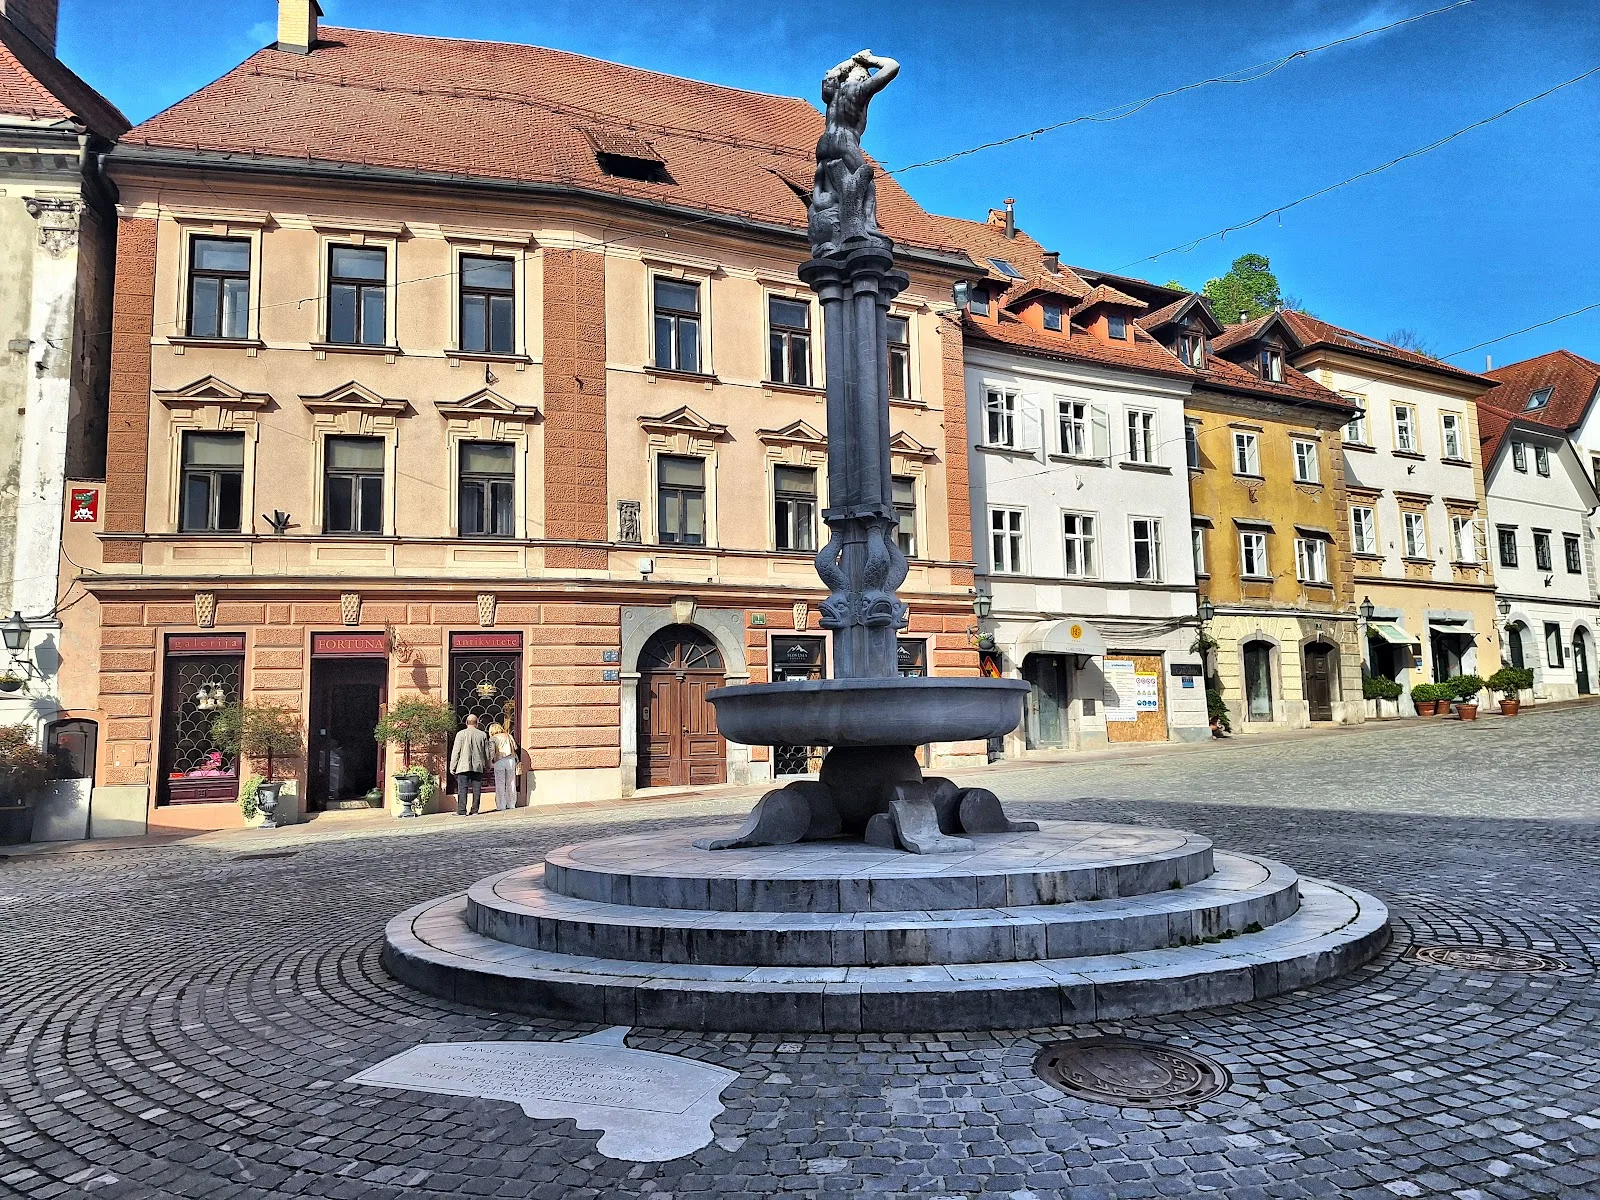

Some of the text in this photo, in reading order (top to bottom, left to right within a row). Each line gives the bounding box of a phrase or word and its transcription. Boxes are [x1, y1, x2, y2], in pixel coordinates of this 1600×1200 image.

[174, 638, 238, 649] galerija
[318, 639, 385, 650] FORTUNA
[456, 637, 517, 646] antikvitete
